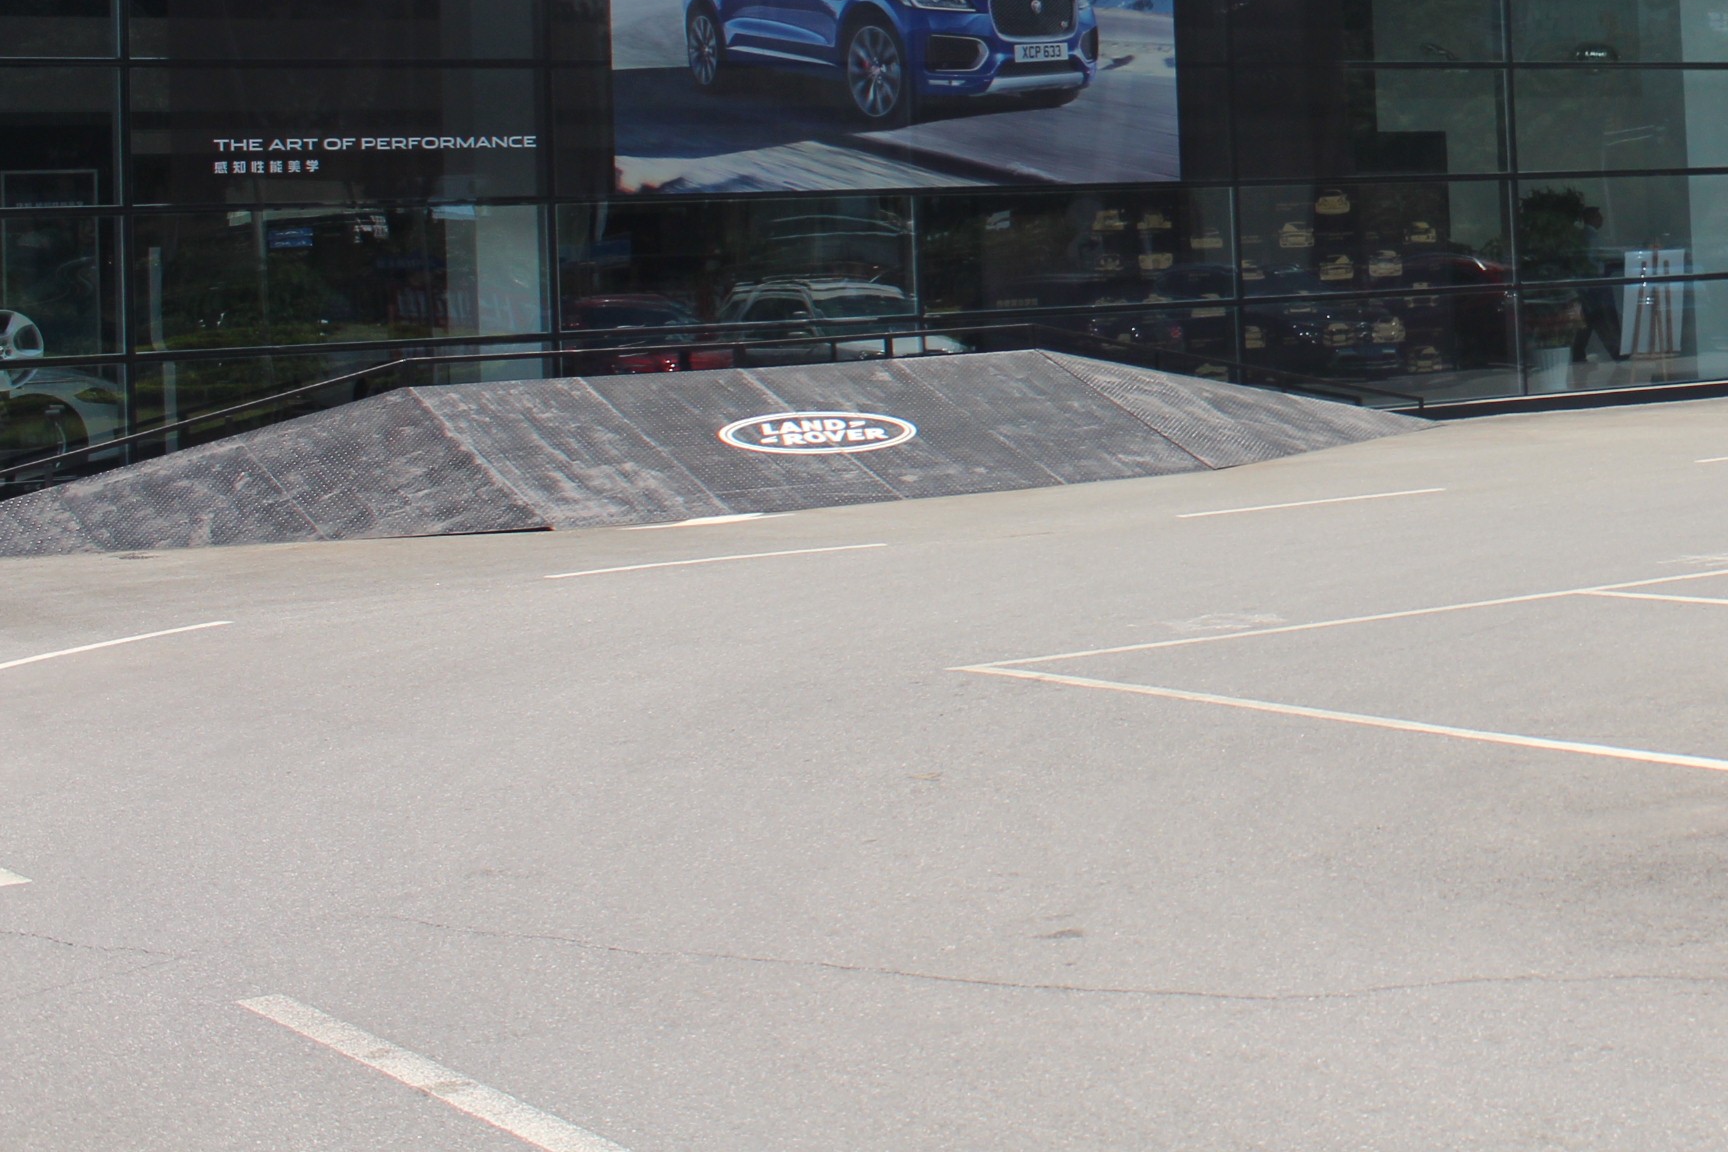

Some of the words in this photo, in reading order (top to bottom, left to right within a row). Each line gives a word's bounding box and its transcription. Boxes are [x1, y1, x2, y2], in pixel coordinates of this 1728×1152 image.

[1022, 45, 1041, 59] XCP
[1043, 44, 1062, 58] 633
[213, 138, 263, 152] THE
[268, 138, 318, 152] ART
[323, 137, 356, 151] OF
[360, 135, 538, 151] PERFORMANCE
[213, 159, 320, 175] 感知性能美学
[761, 419, 848, 436] LAND
[783, 427, 889, 447] ROVER
